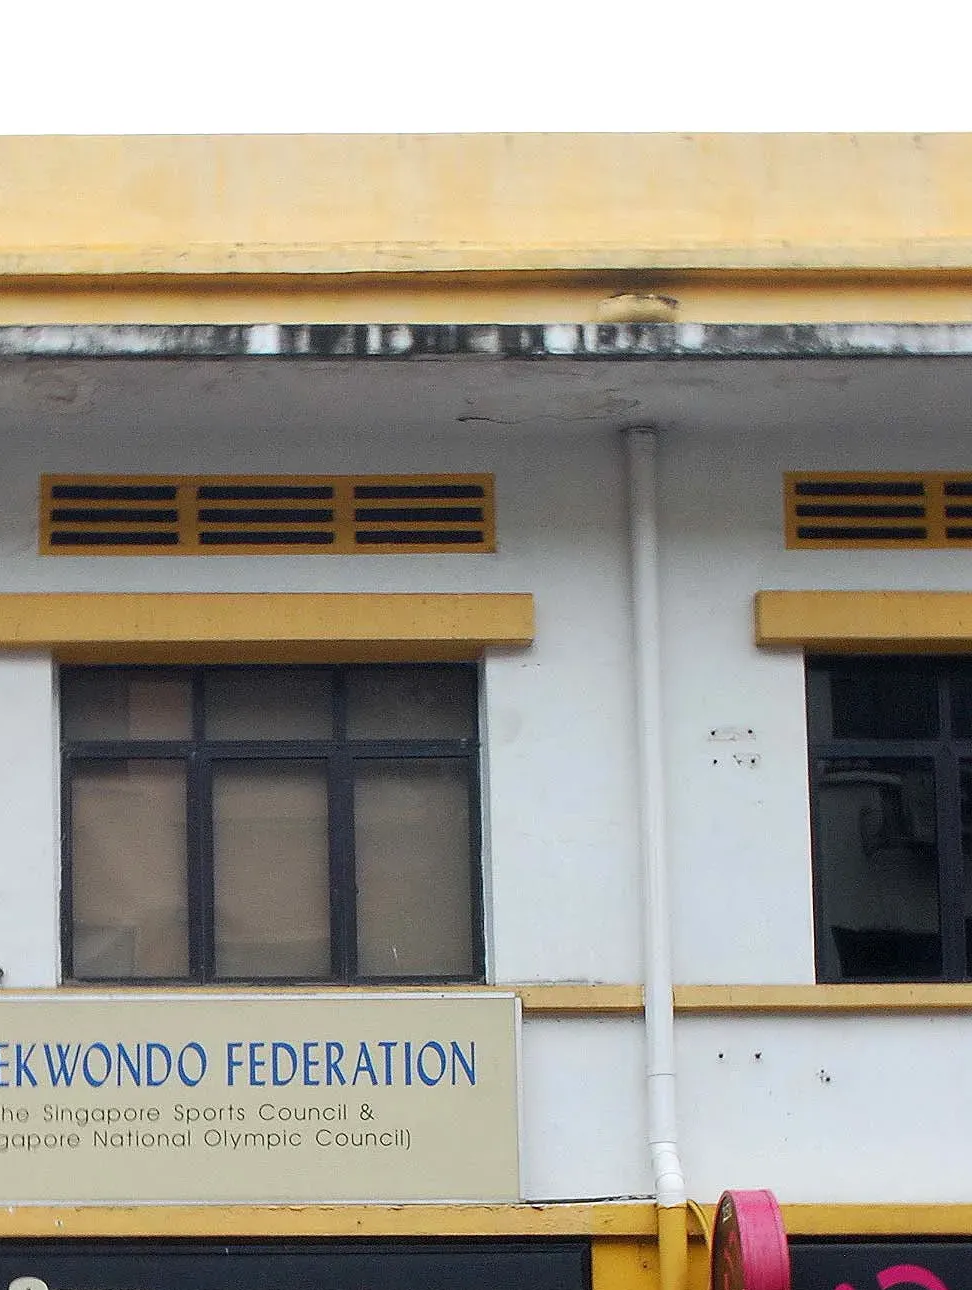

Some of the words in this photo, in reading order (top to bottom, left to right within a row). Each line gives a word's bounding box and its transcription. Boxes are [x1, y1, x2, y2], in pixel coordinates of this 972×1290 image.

[227, 1040, 477, 1088] FEDERATION
[42, 1103, 161, 1127] Singapore
[173, 1103, 246, 1126] Sports
[258, 1103, 348, 1123] Council
[359, 1103, 376, 1122] &
[92, 1129, 194, 1150] National
[203, 1128, 303, 1152] Olympic
[315, 1128, 413, 1151] Council)
